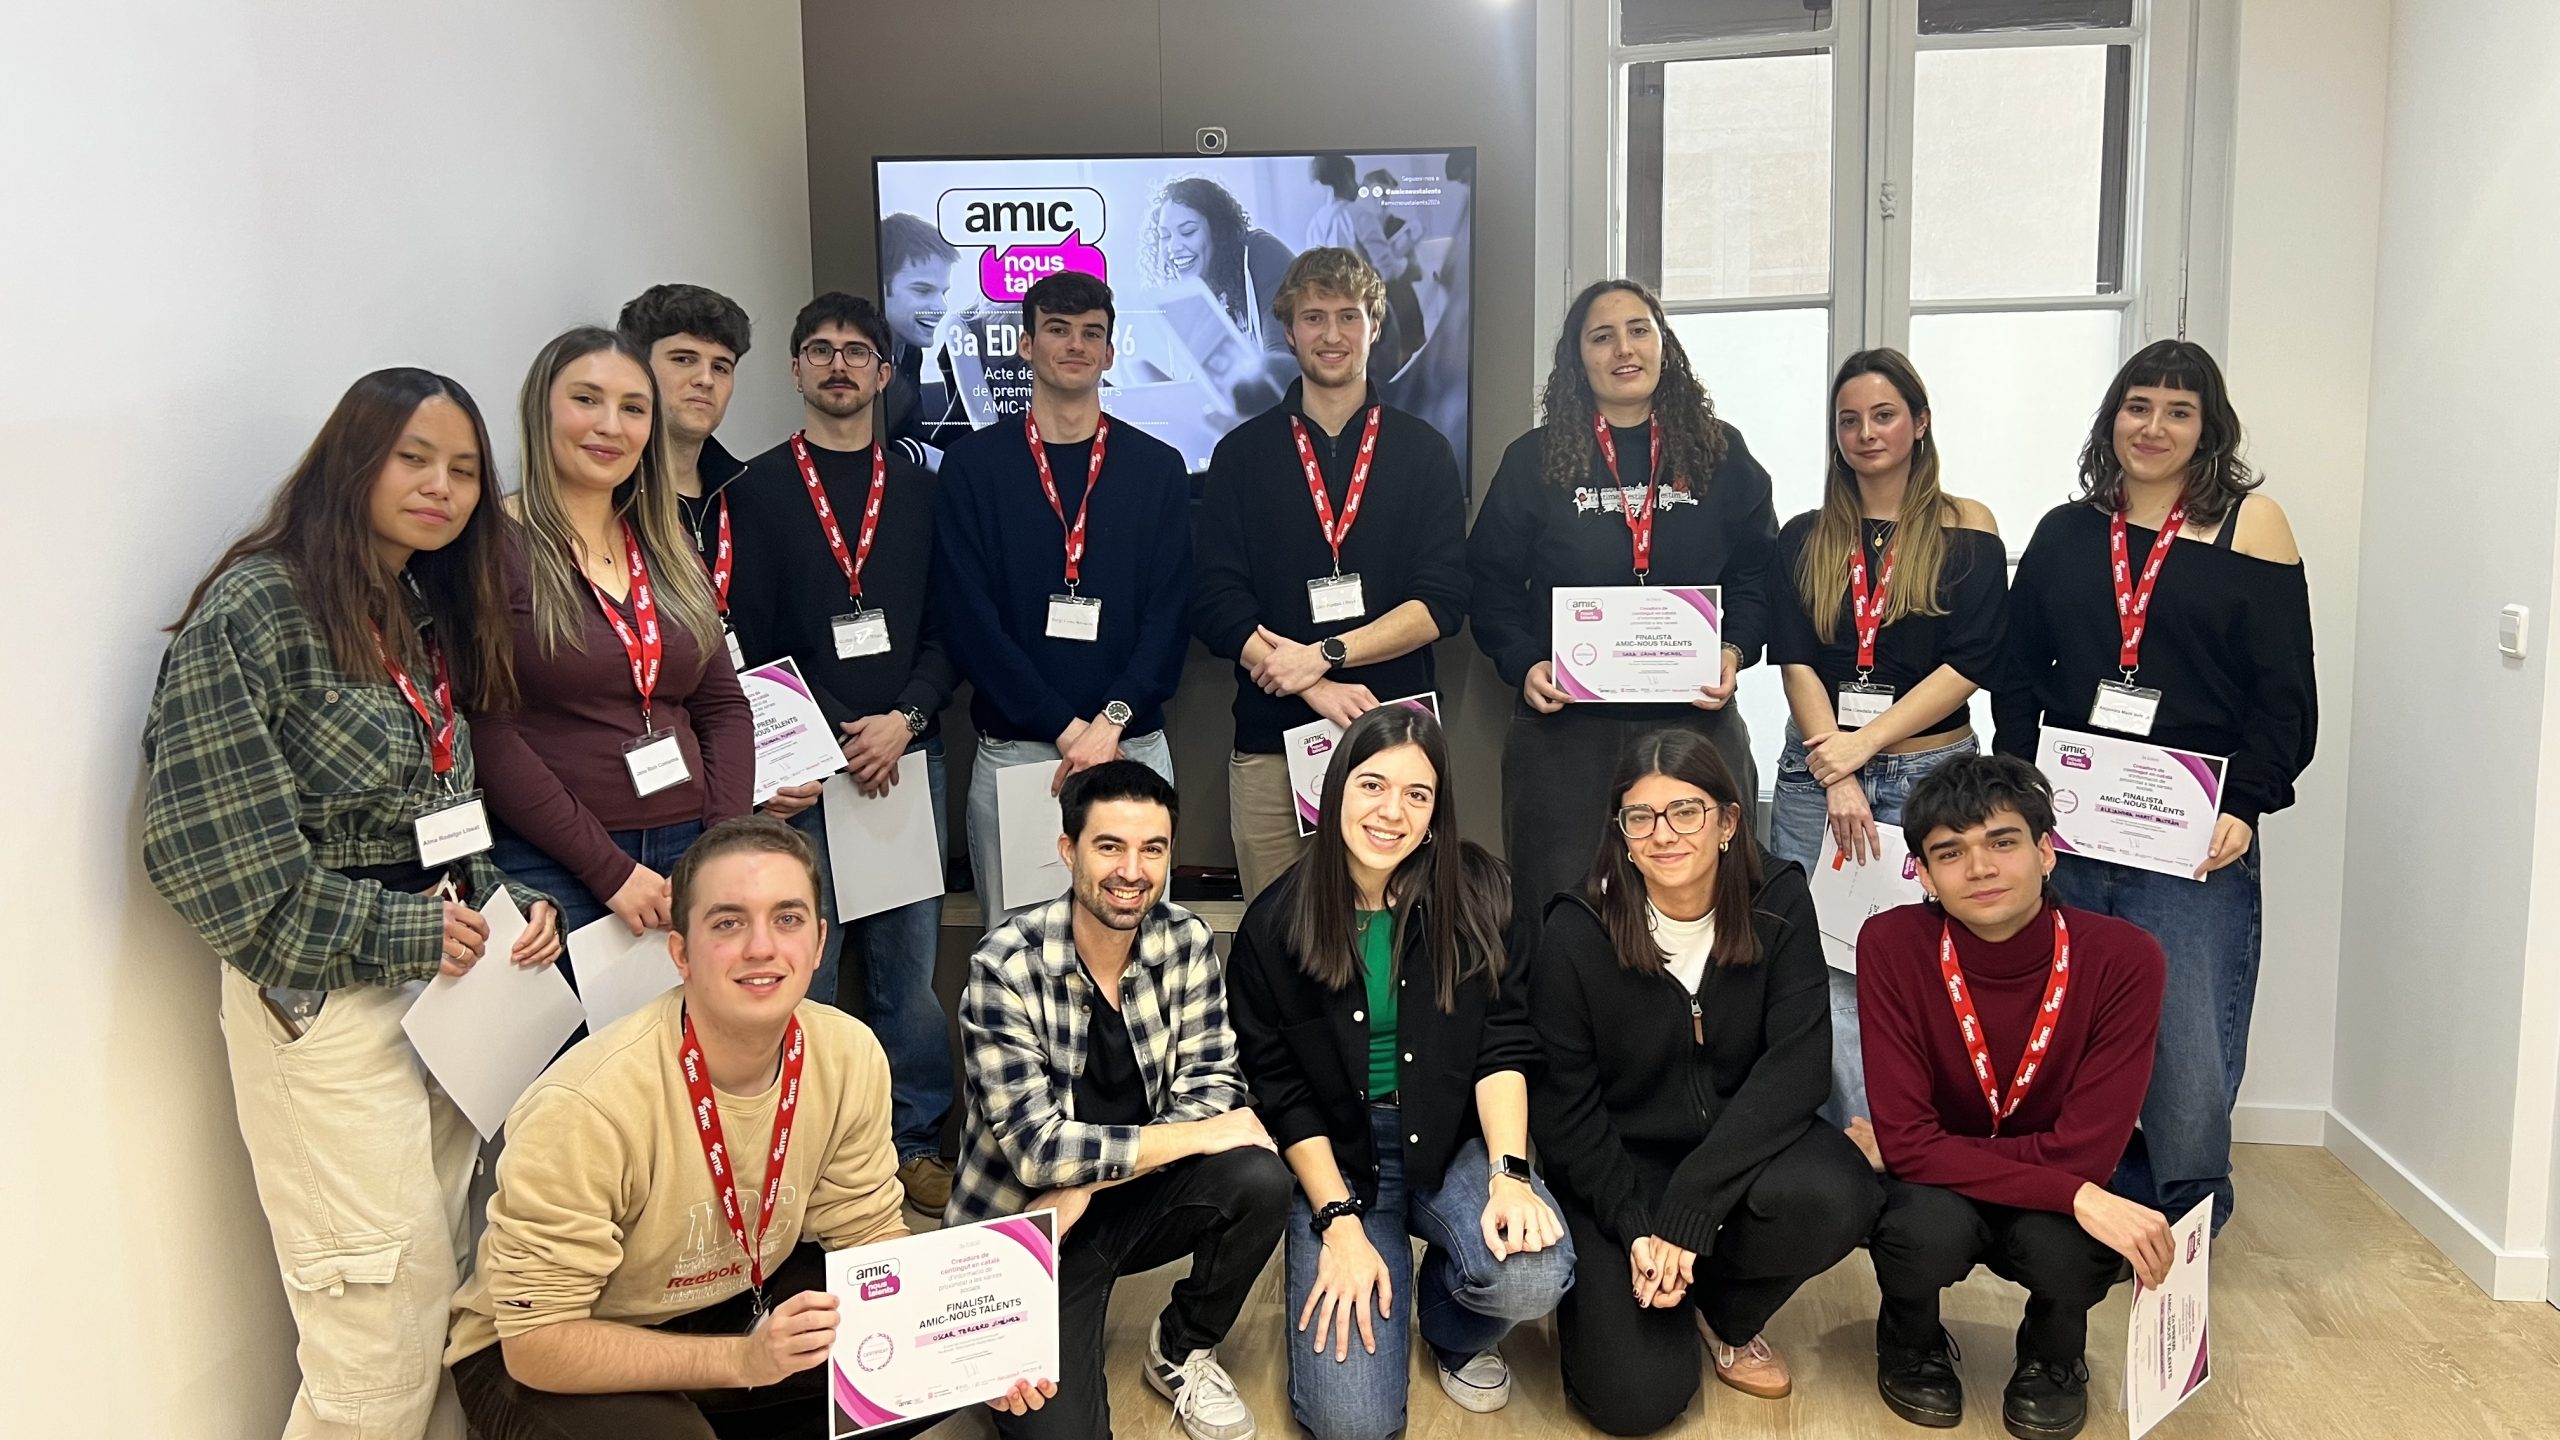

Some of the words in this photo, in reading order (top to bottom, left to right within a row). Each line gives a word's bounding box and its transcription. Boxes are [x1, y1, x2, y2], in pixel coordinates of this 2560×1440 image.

[965, 202, 1074, 232] amic
[1004, 256, 1064, 272] nous
[950, 324, 978, 357] 3a
[984, 367, 1014, 380] Acte
[972, 384, 989, 397] de
[1572, 600, 1597, 608] amic
[772, 716, 798, 732] TALENTS
[2060, 744, 2086, 756] amic
[2100, 794, 2148, 810] AMIC-NOUS
[2149, 804, 2185, 818] TALENTS
[2122, 792, 2164, 806] FINALISTA
[794, 1028, 802, 1055] amic
[684, 1056, 698, 1082] amic
[788, 1078, 798, 1105] amic
[698, 1104, 710, 1130] amic
[778, 1127, 788, 1154] amic
[710, 1150, 724, 1176] amic
[768, 1178, 778, 1204] amic
[723, 1194, 734, 1220] amic
[667, 1262, 743, 1288] Reebok
[856, 1264, 890, 1280] amic
[868, 1281, 888, 1291] nous
[868, 1286, 894, 1298] talents
[919, 1308, 977, 1330] AMIC-NOUS
[979, 1298, 1022, 1316] TALENTS
[946, 1294, 994, 1312] FINALISTA
[932, 1331, 956, 1342] OSCAR
